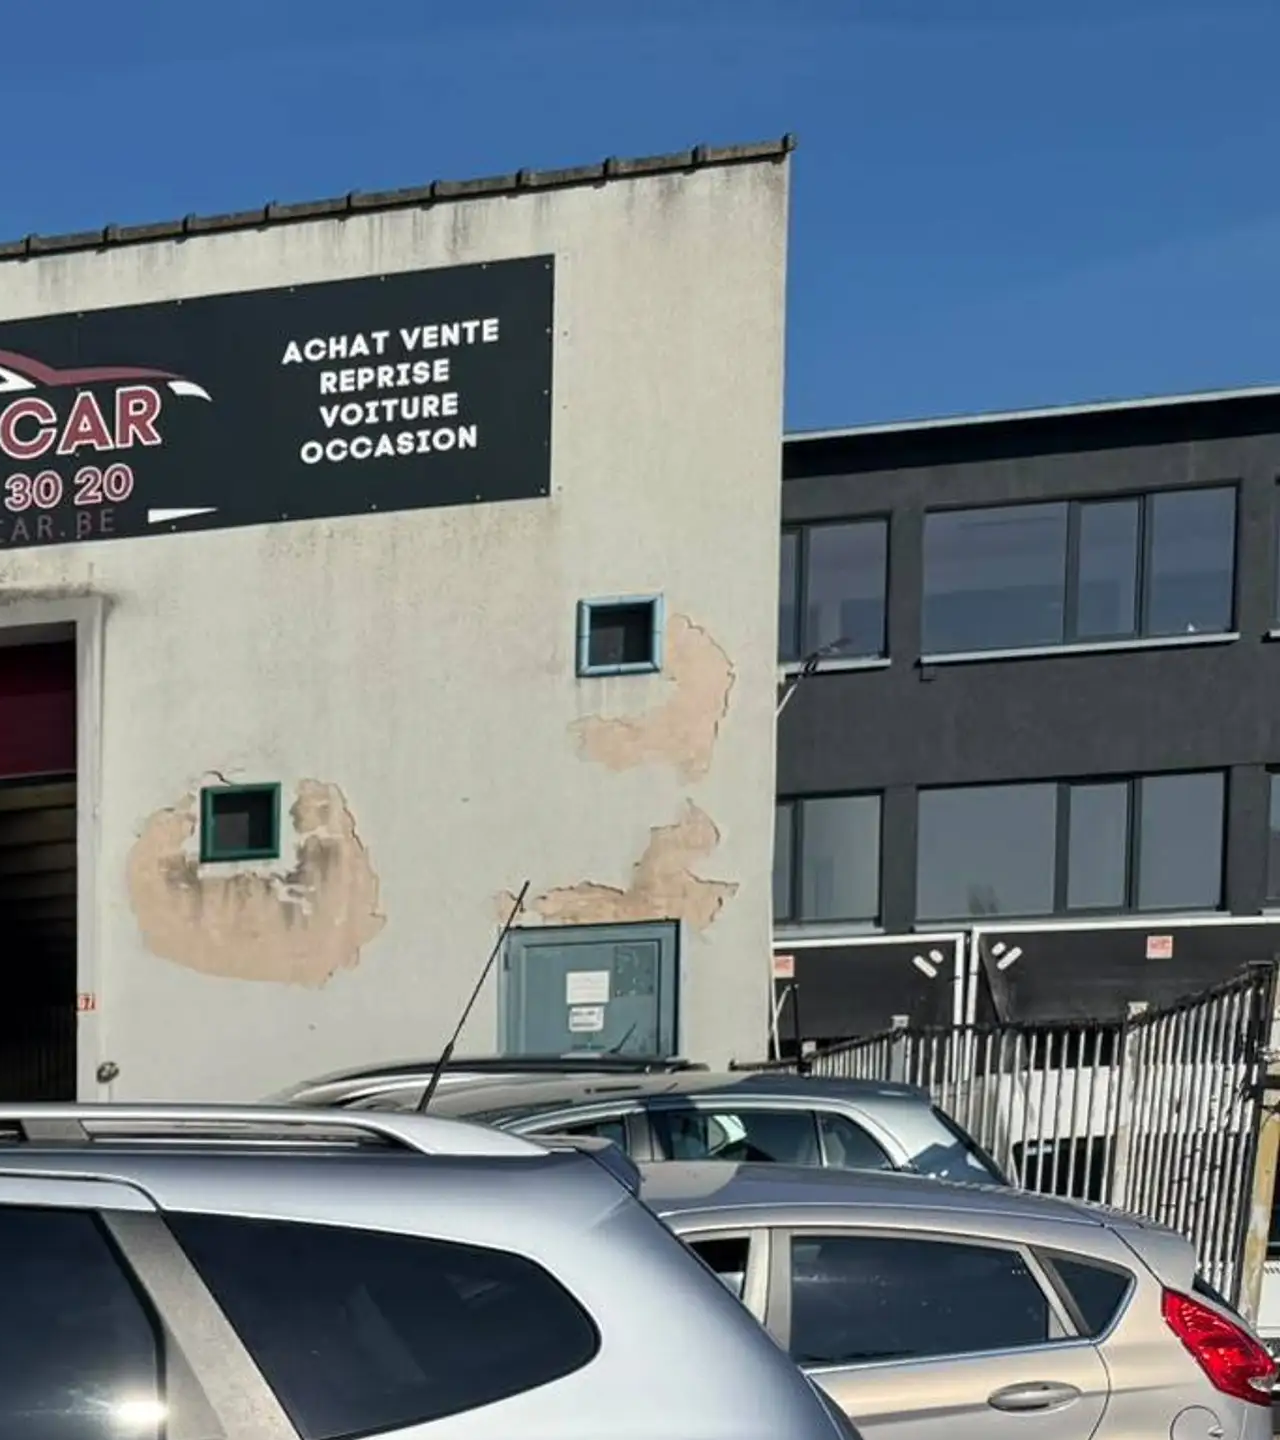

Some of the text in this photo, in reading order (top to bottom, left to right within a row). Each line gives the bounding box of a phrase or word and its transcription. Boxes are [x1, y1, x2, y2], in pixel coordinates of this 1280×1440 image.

[282, 318, 499, 365] ACHAT VENTE
[319, 358, 450, 394] REPRISE
[319, 391, 459, 428] VOITURE
[300, 424, 478, 464] OCCASION
[4, 470, 63, 512] 30
[73, 463, 135, 506] 20
